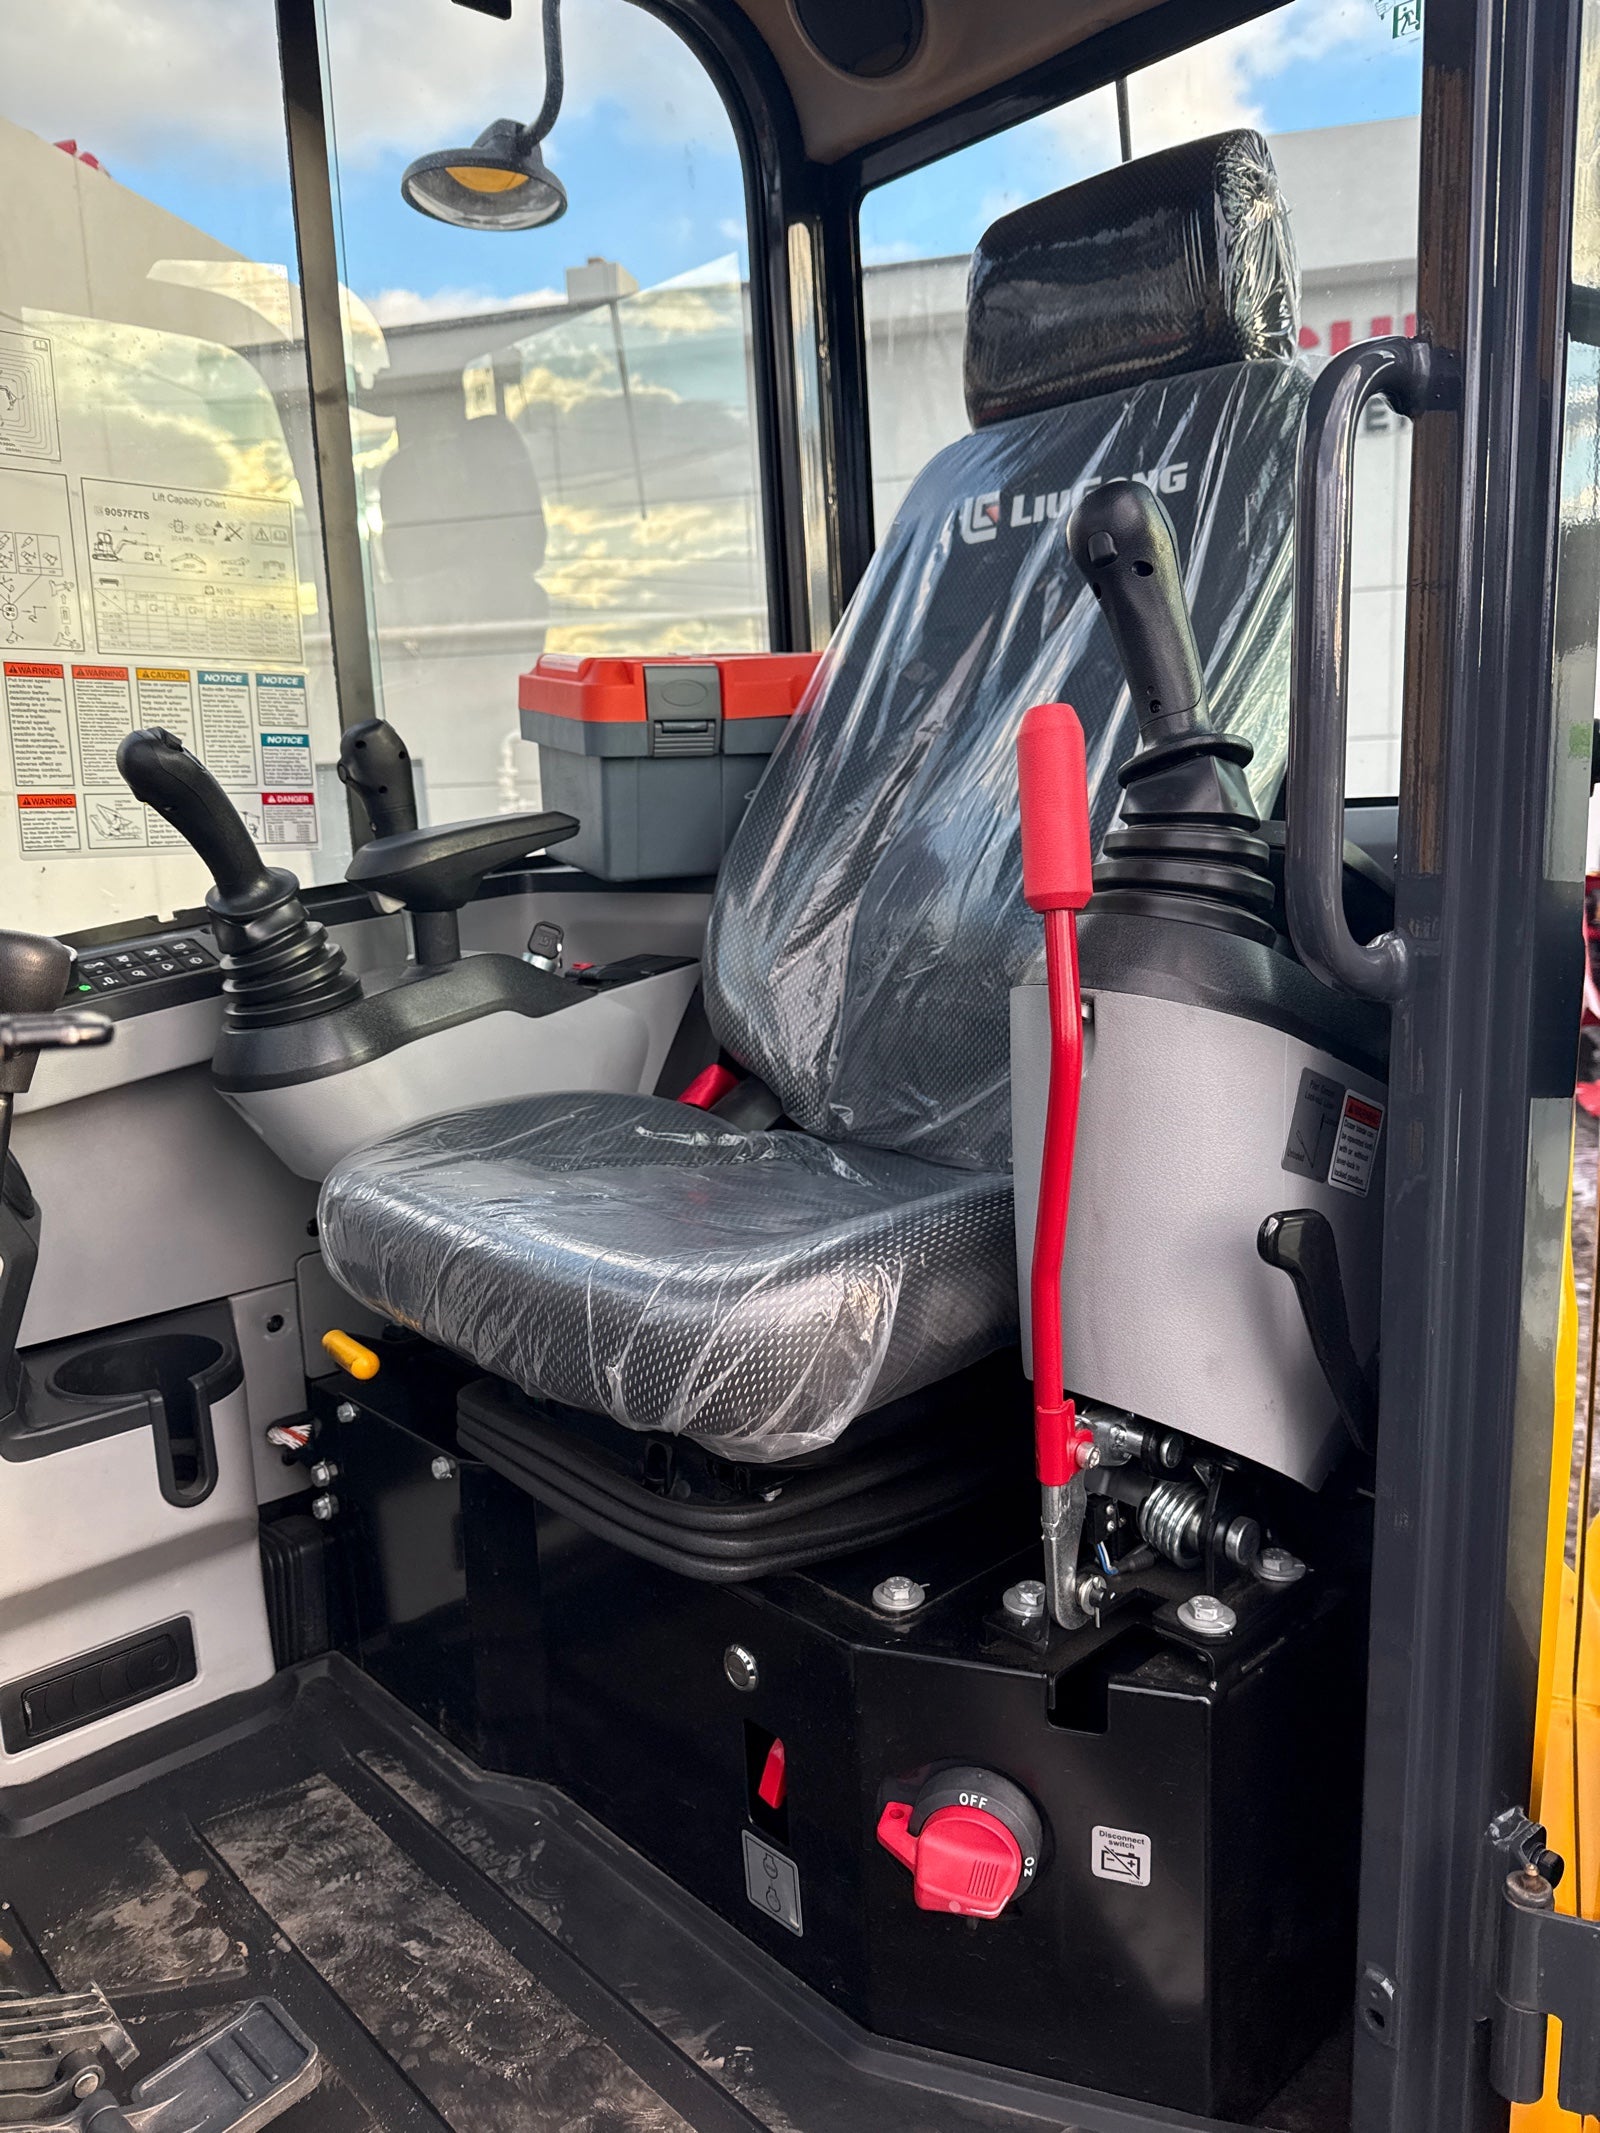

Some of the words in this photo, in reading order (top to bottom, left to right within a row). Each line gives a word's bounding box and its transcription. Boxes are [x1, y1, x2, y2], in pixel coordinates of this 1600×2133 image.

[1010, 462, 1188, 527] LIUGNG
[152, 492, 166, 502] Lift
[167, 494, 202, 508] Capacity
[204, 498, 226, 509] Chart
[104, 507, 150, 520] 9057FZTS
[18, 666, 61, 675] WARNING
[86, 669, 125, 678] WARNING
[150, 671, 186, 679] CAUTION
[204, 674, 242, 683] NOTICE
[262, 676, 299, 685] NOTICE
[267, 736, 304, 744] NOTICE
[31, 797, 73, 805] WARNING
[277, 795, 309, 803] DANGER
[959, 1792, 988, 1808] OFF
[1099, 1830, 1144, 1845] Disconnect
[1108, 1840, 1135, 1849] switch
[1024, 1856, 1035, 1877] ON
